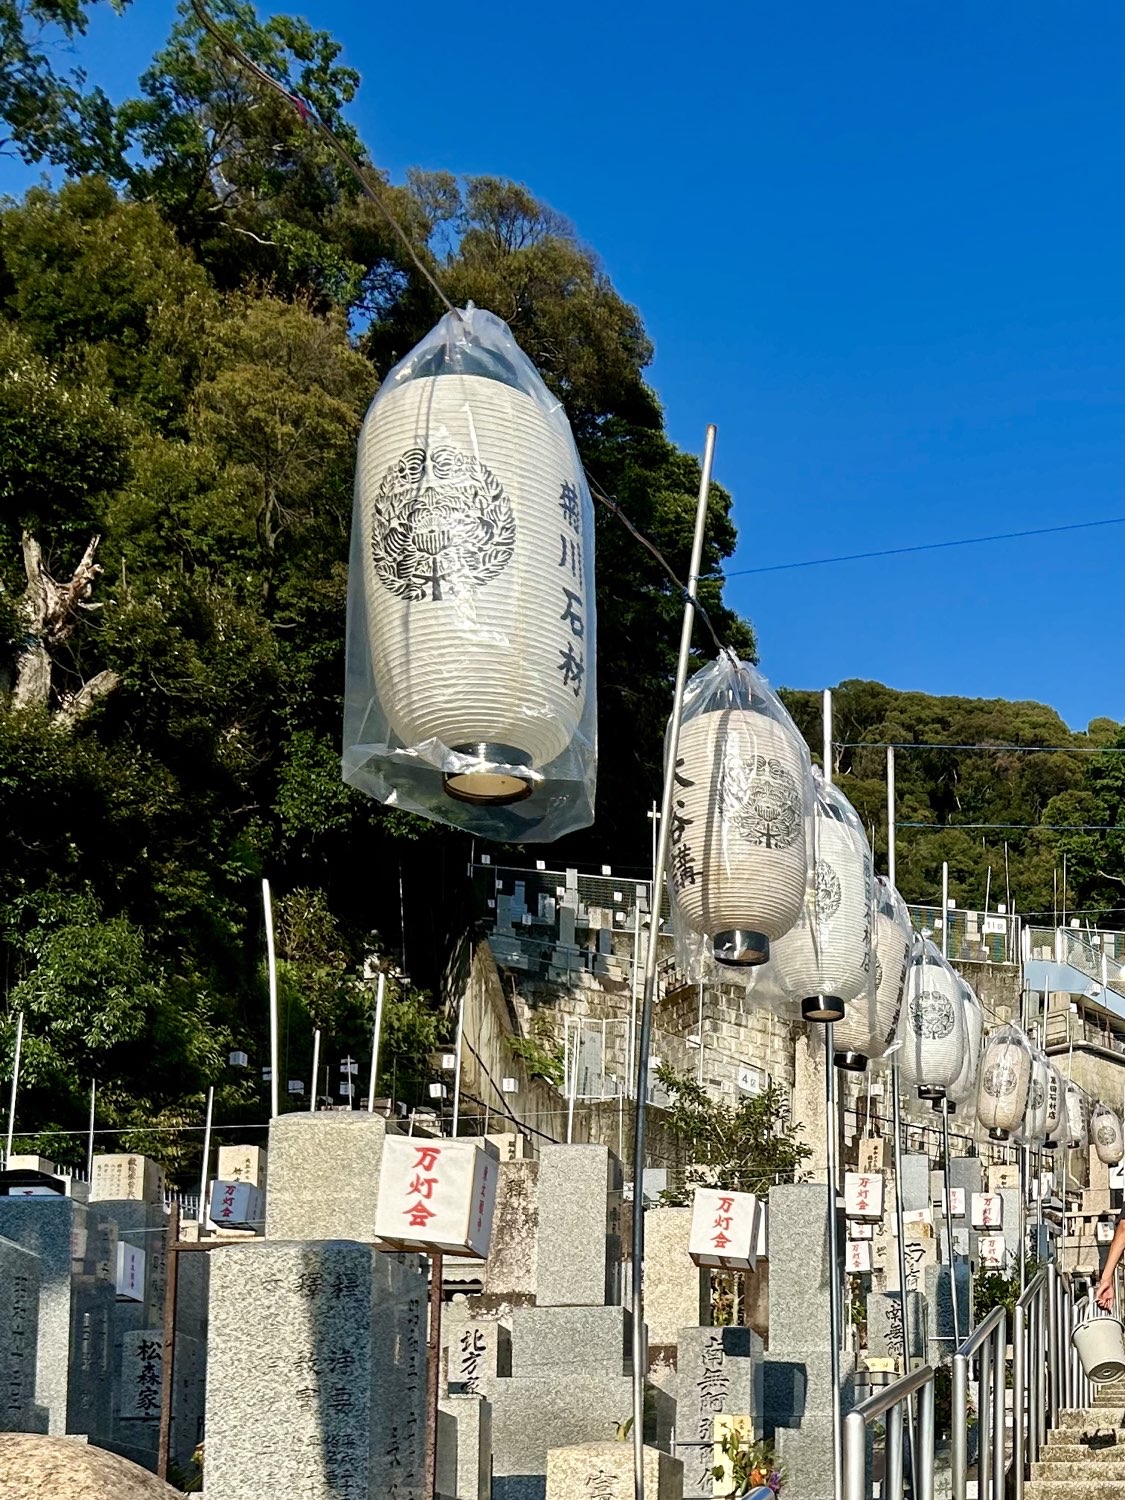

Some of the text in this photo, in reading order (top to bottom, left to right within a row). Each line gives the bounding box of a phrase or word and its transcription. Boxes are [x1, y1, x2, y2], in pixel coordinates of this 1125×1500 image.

[220, 1184, 238, 1218] 万灯会
[402, 1146, 442, 1228] 万灯会
[855, 1177, 871, 1211] 万灯会
[710, 1196, 735, 1249] 万灯会
[459, 1328, 487, 1396] 北方家
